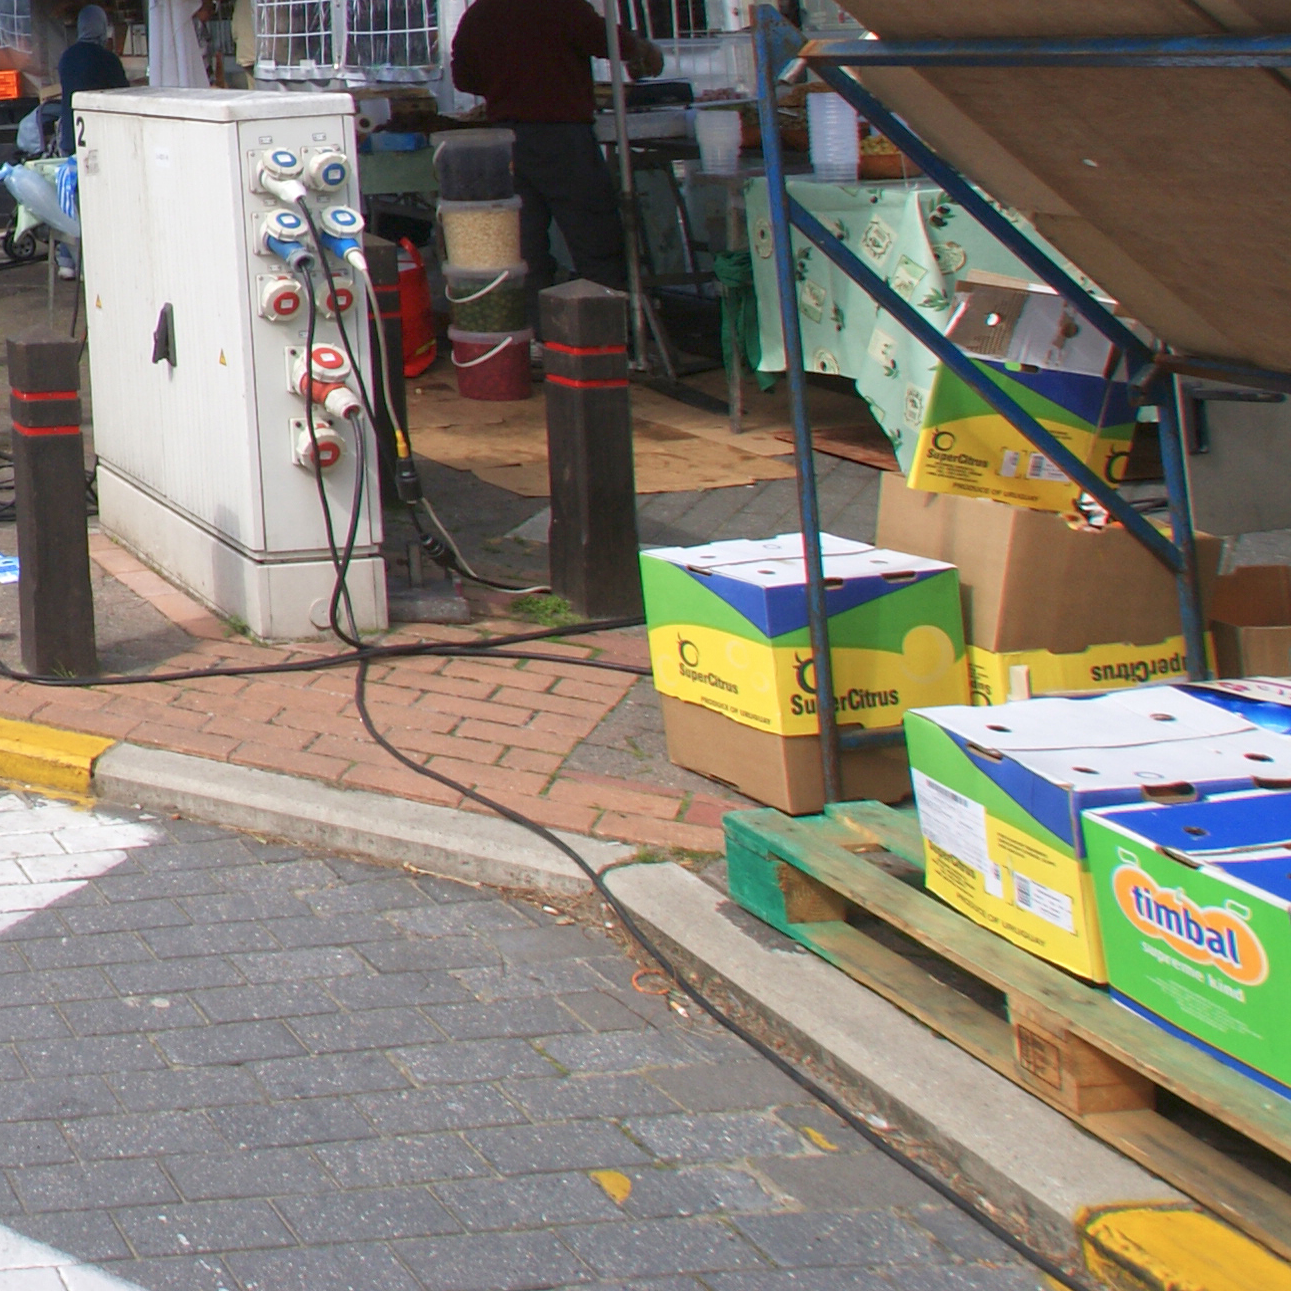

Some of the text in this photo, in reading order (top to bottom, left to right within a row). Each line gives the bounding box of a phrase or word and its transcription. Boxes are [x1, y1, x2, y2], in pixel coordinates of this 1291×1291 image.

[76, 116, 86, 147] 2
[926, 447, 989, 468] SuperCitrus
[952, 482, 989, 493] PRODUCE
[1003, 490, 1039, 501] URUGUAY
[679, 663, 739, 694] SuperCitrus
[700, 696, 729, 711] PRODUCE
[740, 710, 772, 725] URUGUAY
[790, 688, 899, 715] SuerCitrus
[956, 892, 987, 919] PRODUCE
[1001, 920, 1047, 947] URUGUAY
[1131, 884, 1241, 969] timbal
[1140, 940, 1246, 1004] supreme kind
